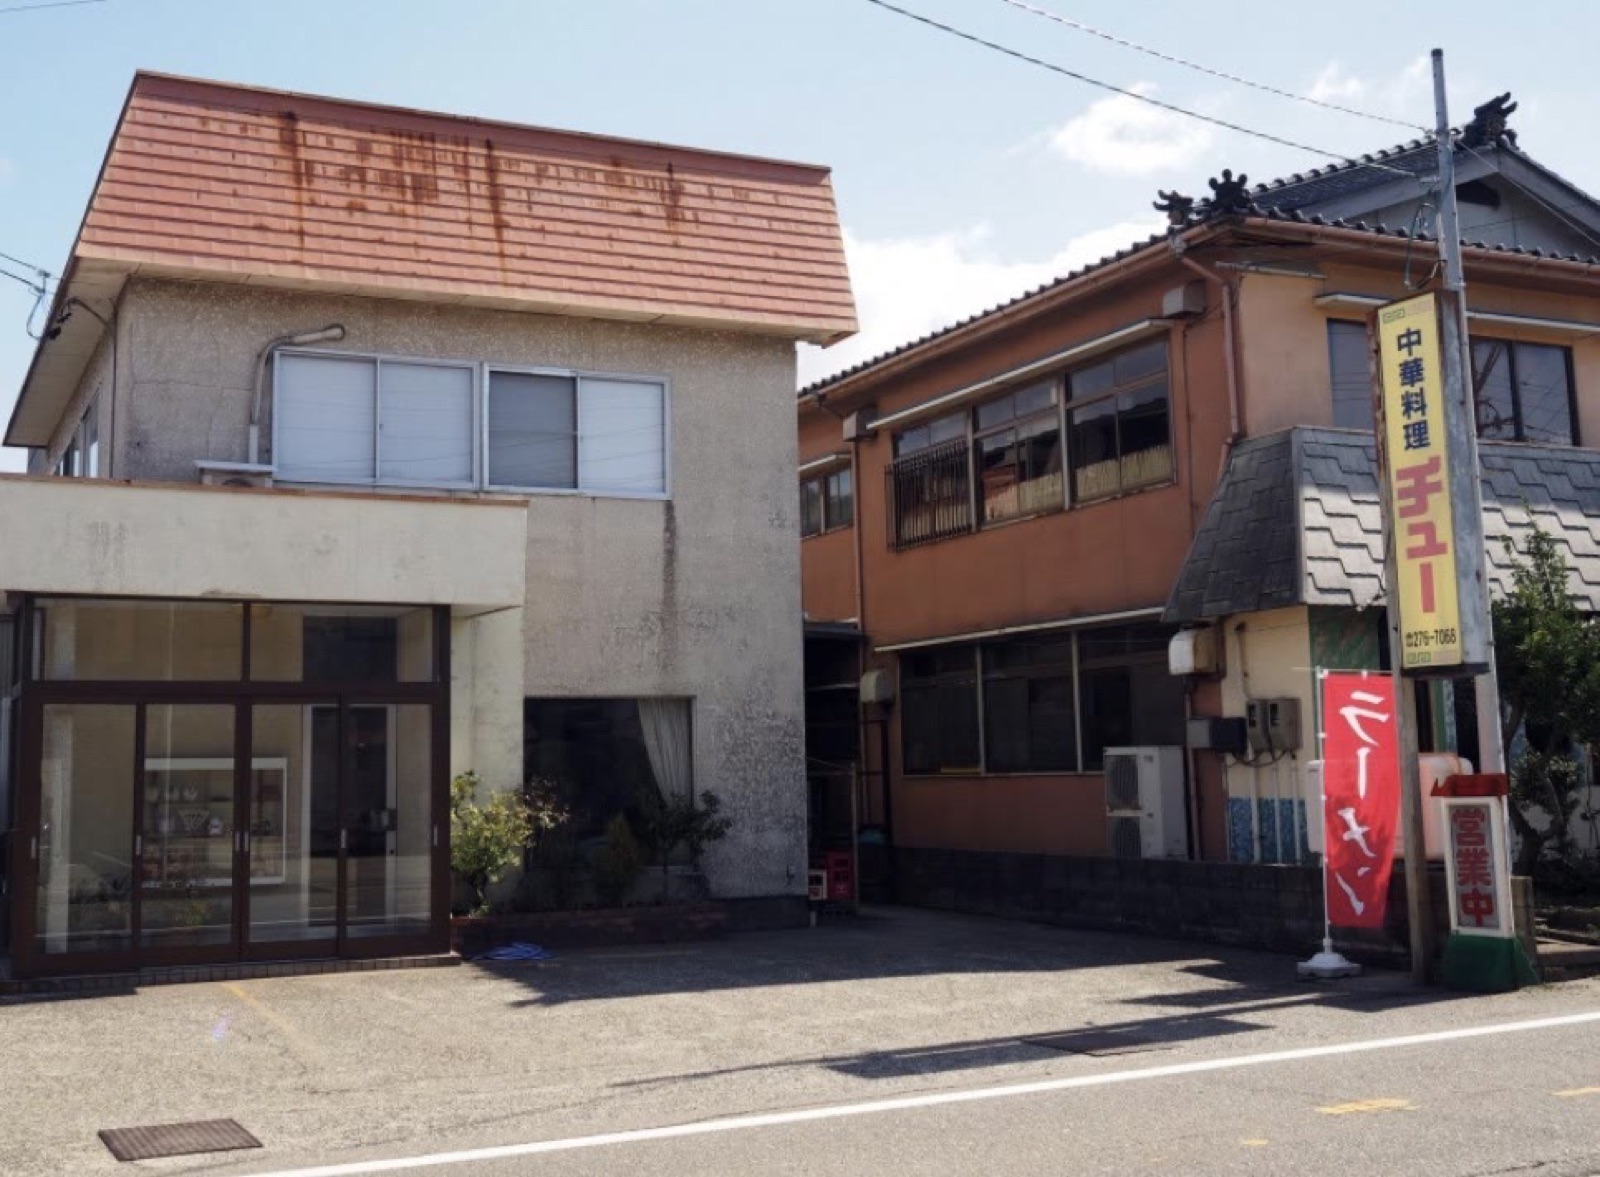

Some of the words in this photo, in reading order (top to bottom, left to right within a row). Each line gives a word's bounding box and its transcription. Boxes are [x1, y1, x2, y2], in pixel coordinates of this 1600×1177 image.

[1397, 327, 1431, 450] 中華料理
[1396, 456, 1448, 613] チュー
[1335, 691, 1389, 916] ラーメン
[1452, 809, 1494, 926] 営業中
